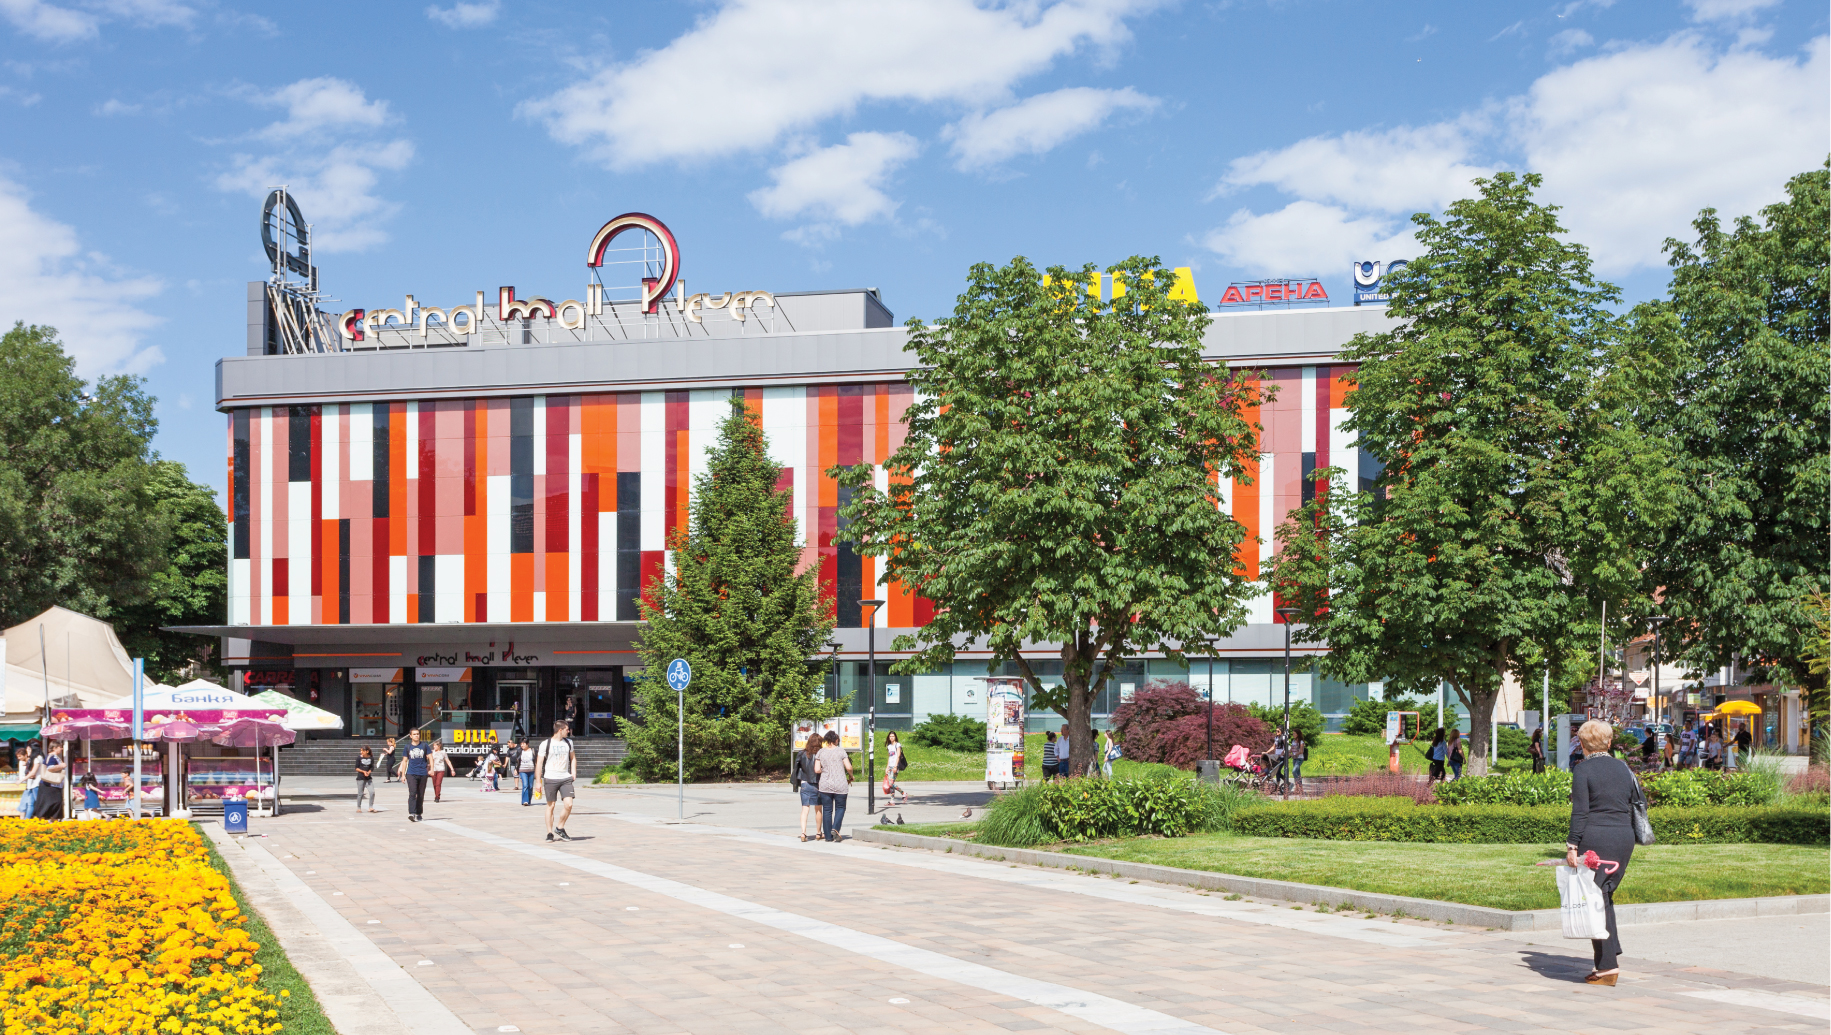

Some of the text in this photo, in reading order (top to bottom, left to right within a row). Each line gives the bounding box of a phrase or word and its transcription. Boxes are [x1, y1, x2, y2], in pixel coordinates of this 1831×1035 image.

[338, 290, 484, 342] central
[587, 212, 775, 323] Pleven
[1219, 281, 1328, 304] АРЕНА
[1360, 293, 1389, 301] UNITED
[417, 652, 457, 666] central
[243, 671, 318, 685] CARREA
[171, 693, 234, 703] Банкя
[453, 729, 499, 743] BILLA
